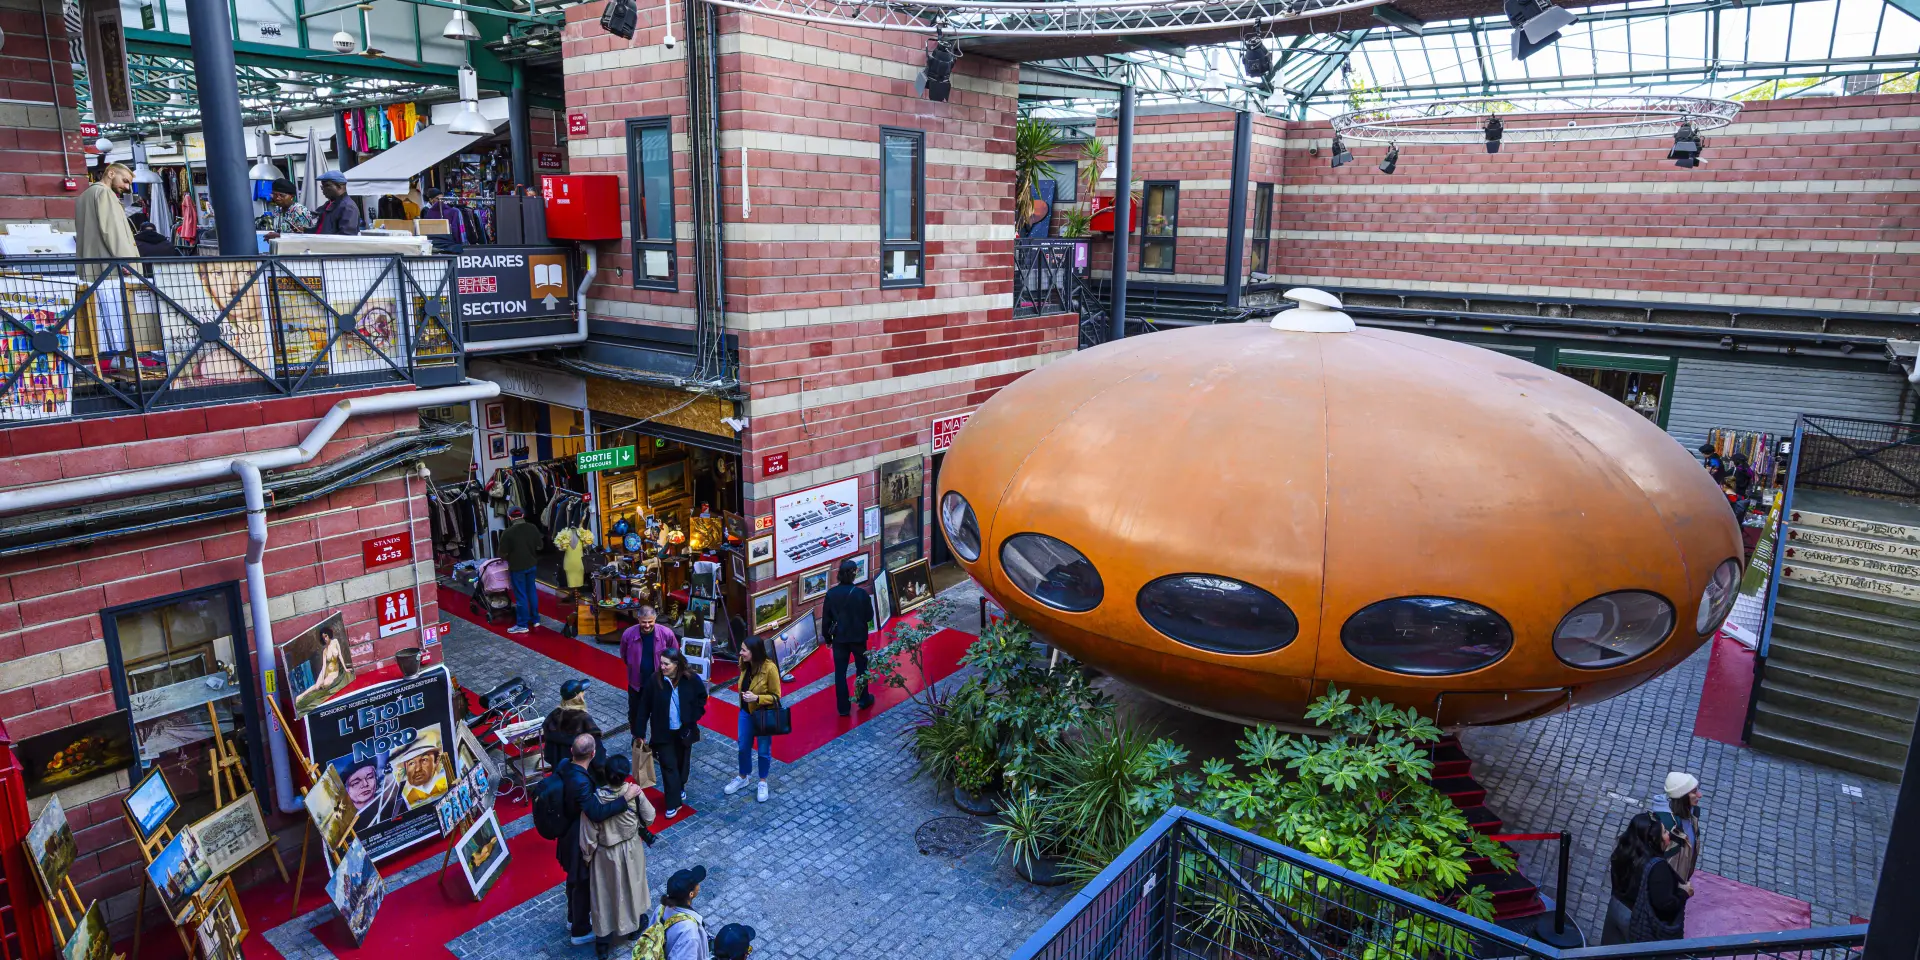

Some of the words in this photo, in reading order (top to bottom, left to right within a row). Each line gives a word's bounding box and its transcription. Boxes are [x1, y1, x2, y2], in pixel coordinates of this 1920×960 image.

[457, 254, 524, 269] IBRAIRES
[462, 300, 527, 316] SECTION
[580, 452, 612, 464] SORTIE
[588, 460, 612, 469] SECOURS
[1821, 516, 1859, 529] ESPACE
[1866, 522, 1906, 536] DESIGN
[373, 536, 401, 548] STANDS
[1801, 531, 1884, 552] RESTAURATEURS
[375, 550, 402, 562] 43-53
[373, 717, 400, 738] DU
[351, 727, 418, 764] NORD
[441, 766, 490, 831] PARS
